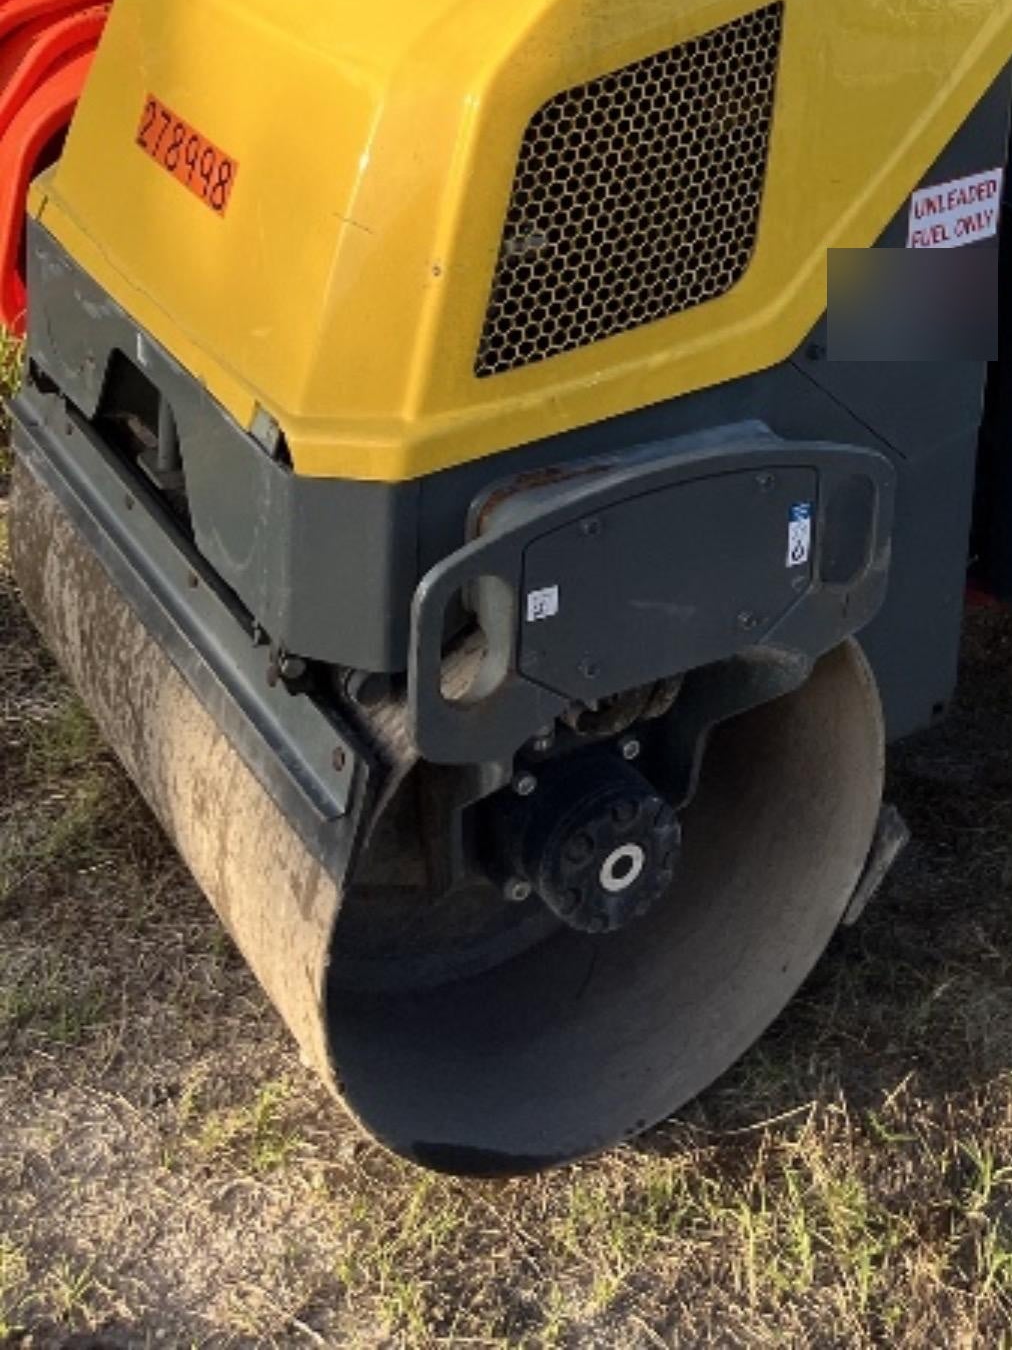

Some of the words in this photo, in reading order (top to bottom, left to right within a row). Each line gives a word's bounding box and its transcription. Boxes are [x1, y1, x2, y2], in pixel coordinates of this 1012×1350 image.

[135, 100, 233, 212] 278998
[914, 179, 998, 220] UNLEADED
[911, 224, 950, 248] FUEL
[954, 209, 994, 238] ONLY
